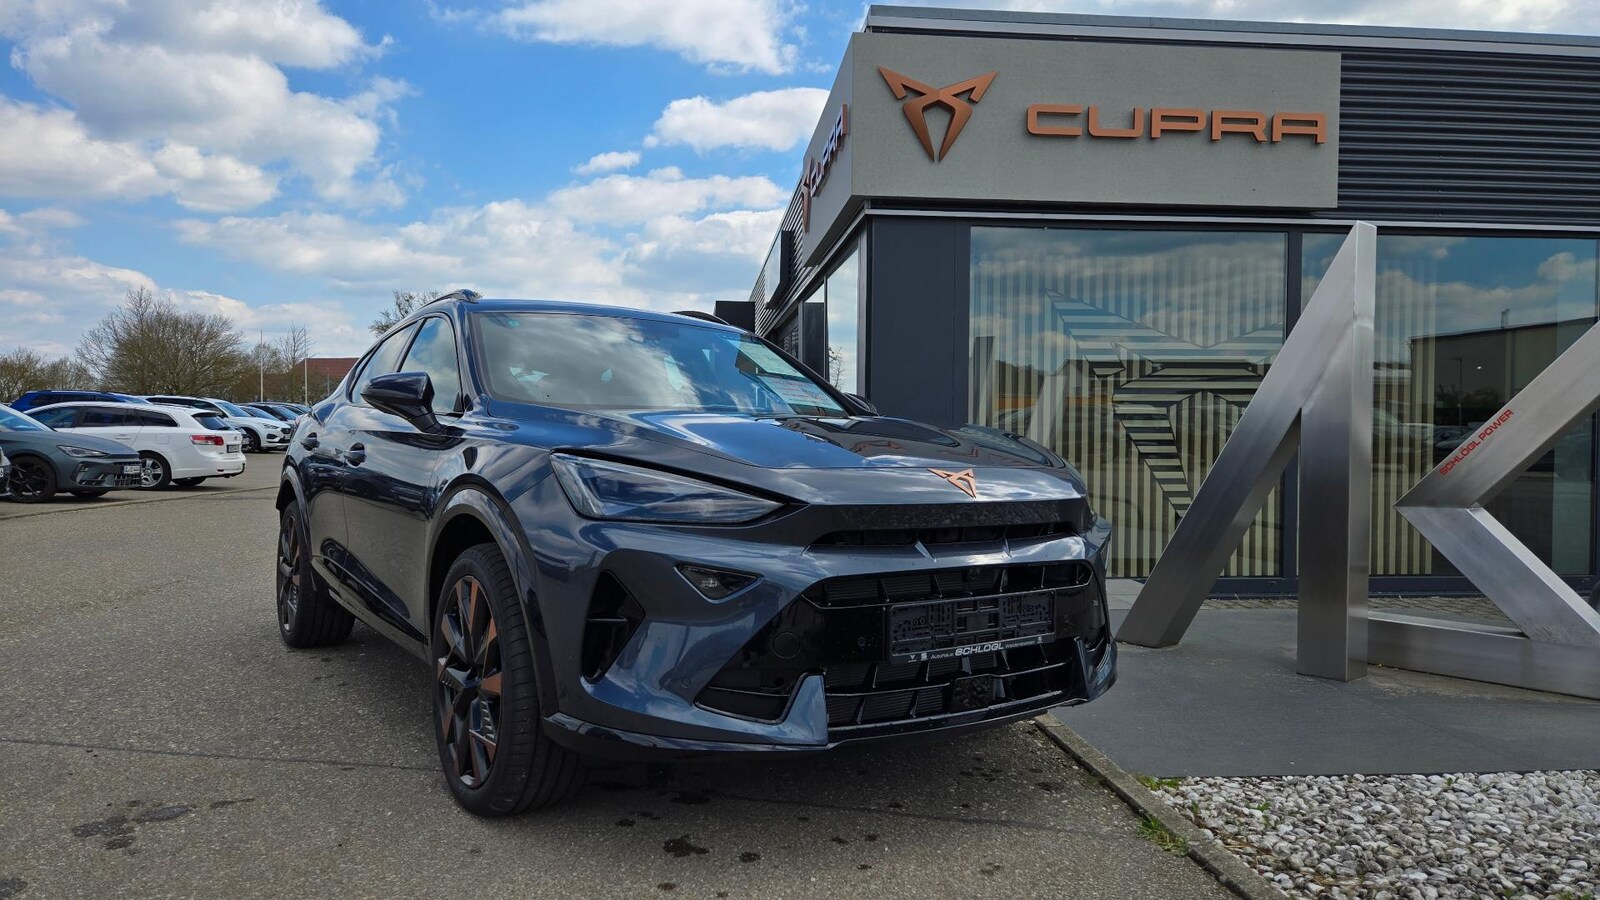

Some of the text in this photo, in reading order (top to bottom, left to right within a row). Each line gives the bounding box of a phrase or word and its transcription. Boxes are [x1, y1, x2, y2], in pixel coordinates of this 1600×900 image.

[1027, 104, 1327, 144] CUPRA
[1439, 409, 1514, 476] SCHLÖGL POWER
